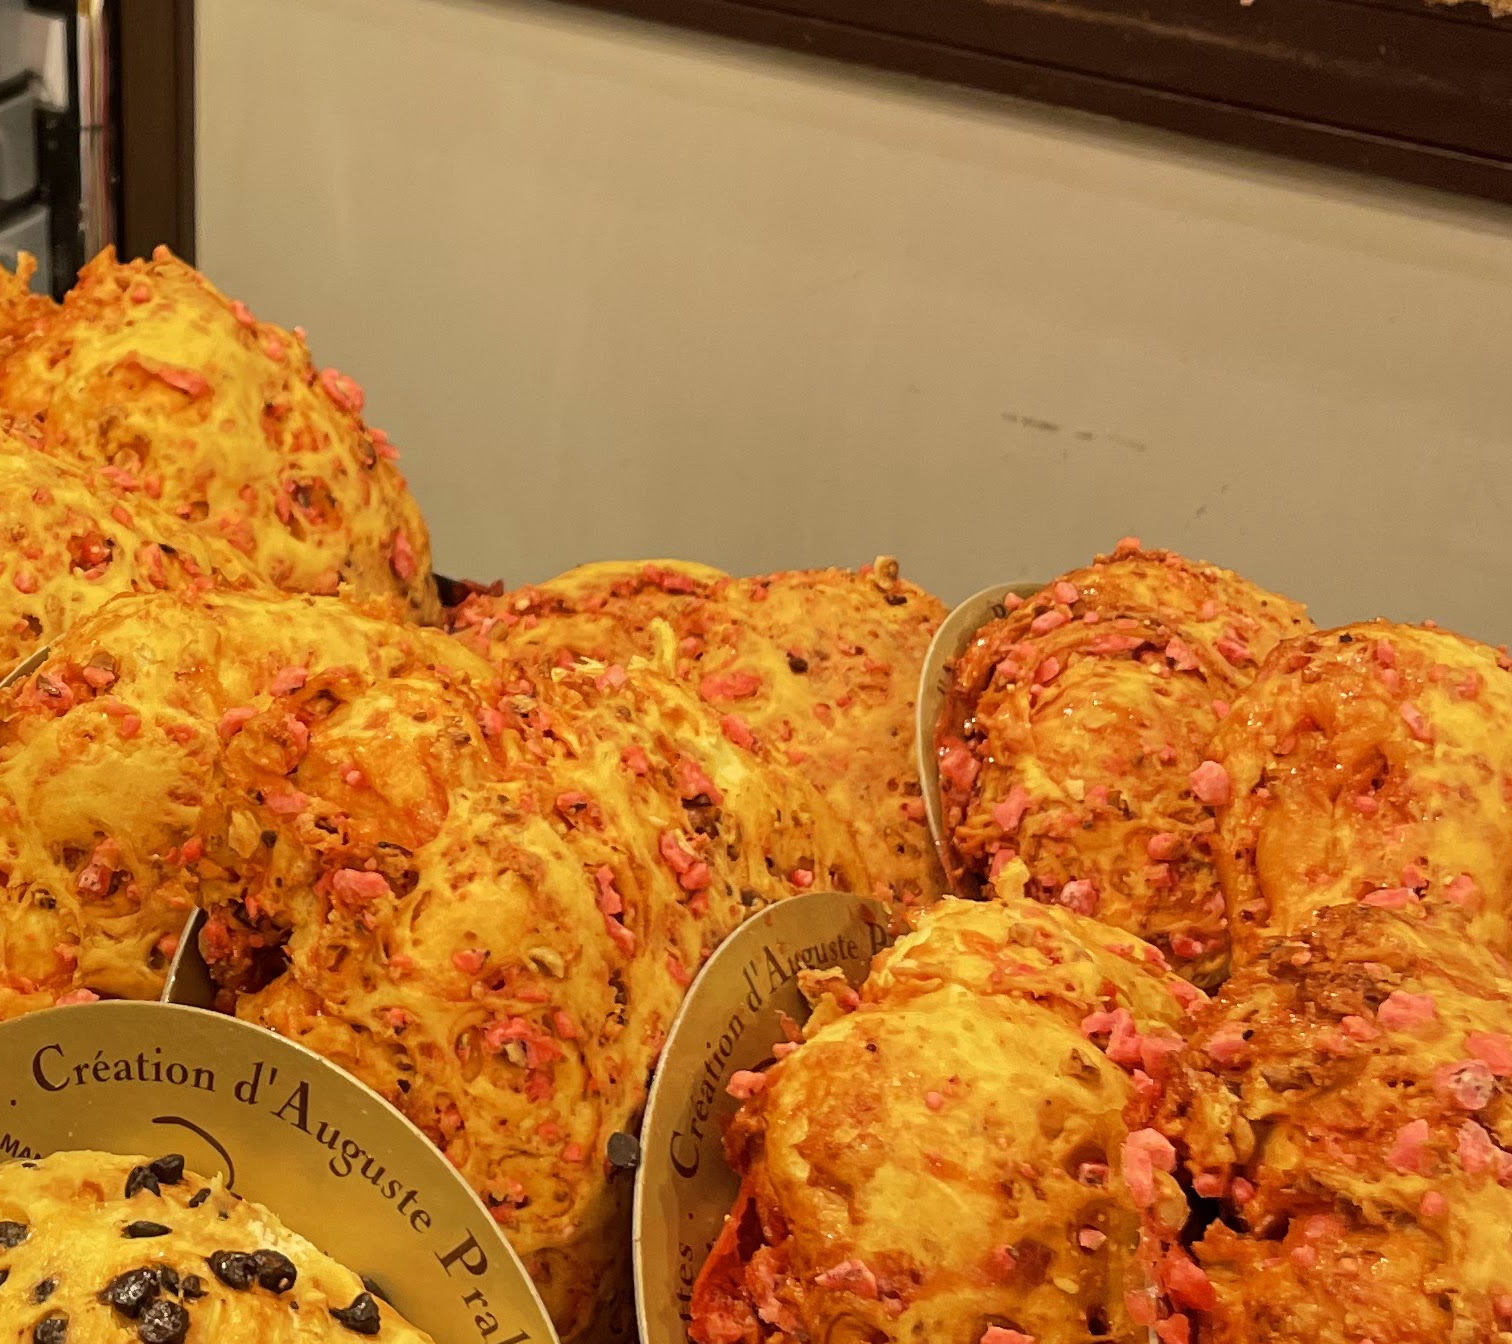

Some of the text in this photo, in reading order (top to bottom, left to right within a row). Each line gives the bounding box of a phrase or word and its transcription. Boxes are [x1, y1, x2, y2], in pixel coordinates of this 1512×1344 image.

[31, 1042, 217, 1094] Création
[233, 1060, 433, 1234] d'Auguste
[669, 932, 859, 1180] Création d'Auguste
